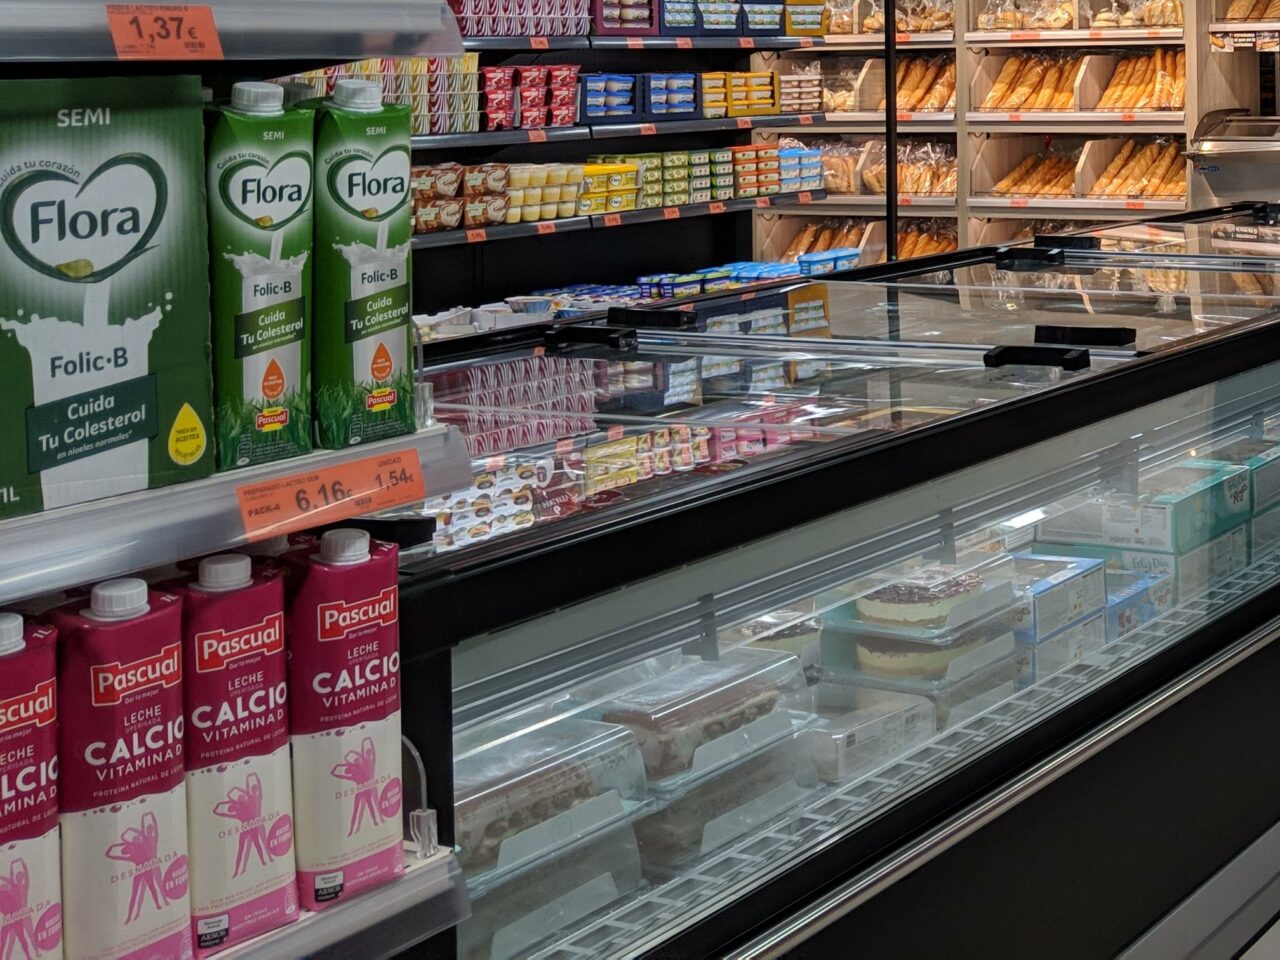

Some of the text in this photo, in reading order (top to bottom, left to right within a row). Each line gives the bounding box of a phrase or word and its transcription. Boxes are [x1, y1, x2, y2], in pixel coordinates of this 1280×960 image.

[129, 15, 199, 44] 1,37€
[57, 108, 111, 127] SEMI
[366, 126, 387, 136] SEMI
[263, 131, 285, 140] SEMI
[24, 161, 36, 169] tu
[39, 159, 81, 178] corazón
[241, 178, 302, 205] Flora
[348, 171, 405, 198] Flora
[30, 199, 141, 245] Flora
[350, 319, 364, 331] Tu
[364, 302, 409, 327] Colesterol
[366, 296, 393, 312] Cuida
[240, 332, 255, 345] Tu
[256, 317, 304, 341] Colesterol
[258, 310, 286, 326] Cuida
[67, 395, 115, 420] Cuida
[368, 393, 394, 406] Pascual
[38, 404, 146, 452] Tu Colesterol
[258, 412, 286, 424] Pascual
[57, 451, 67, 460] en
[67, 442, 95, 457] niveles
[325, 593, 394, 630] Pascual
[203, 620, 279, 660] Pascual
[347, 641, 379, 660] LECHE
[98, 650, 178, 693] Pascual
[228, 670, 264, 691] LECHE
[312, 651, 400, 694] CALCIO
[0, 687, 52, 725] scual
[124, 704, 162, 727] LECHE
[191, 681, 287, 729] CALCIO
[84, 714, 184, 766] CALCIO
[0, 744, 35, 766] ECHE
[0, 754, 58, 800] LCIO
